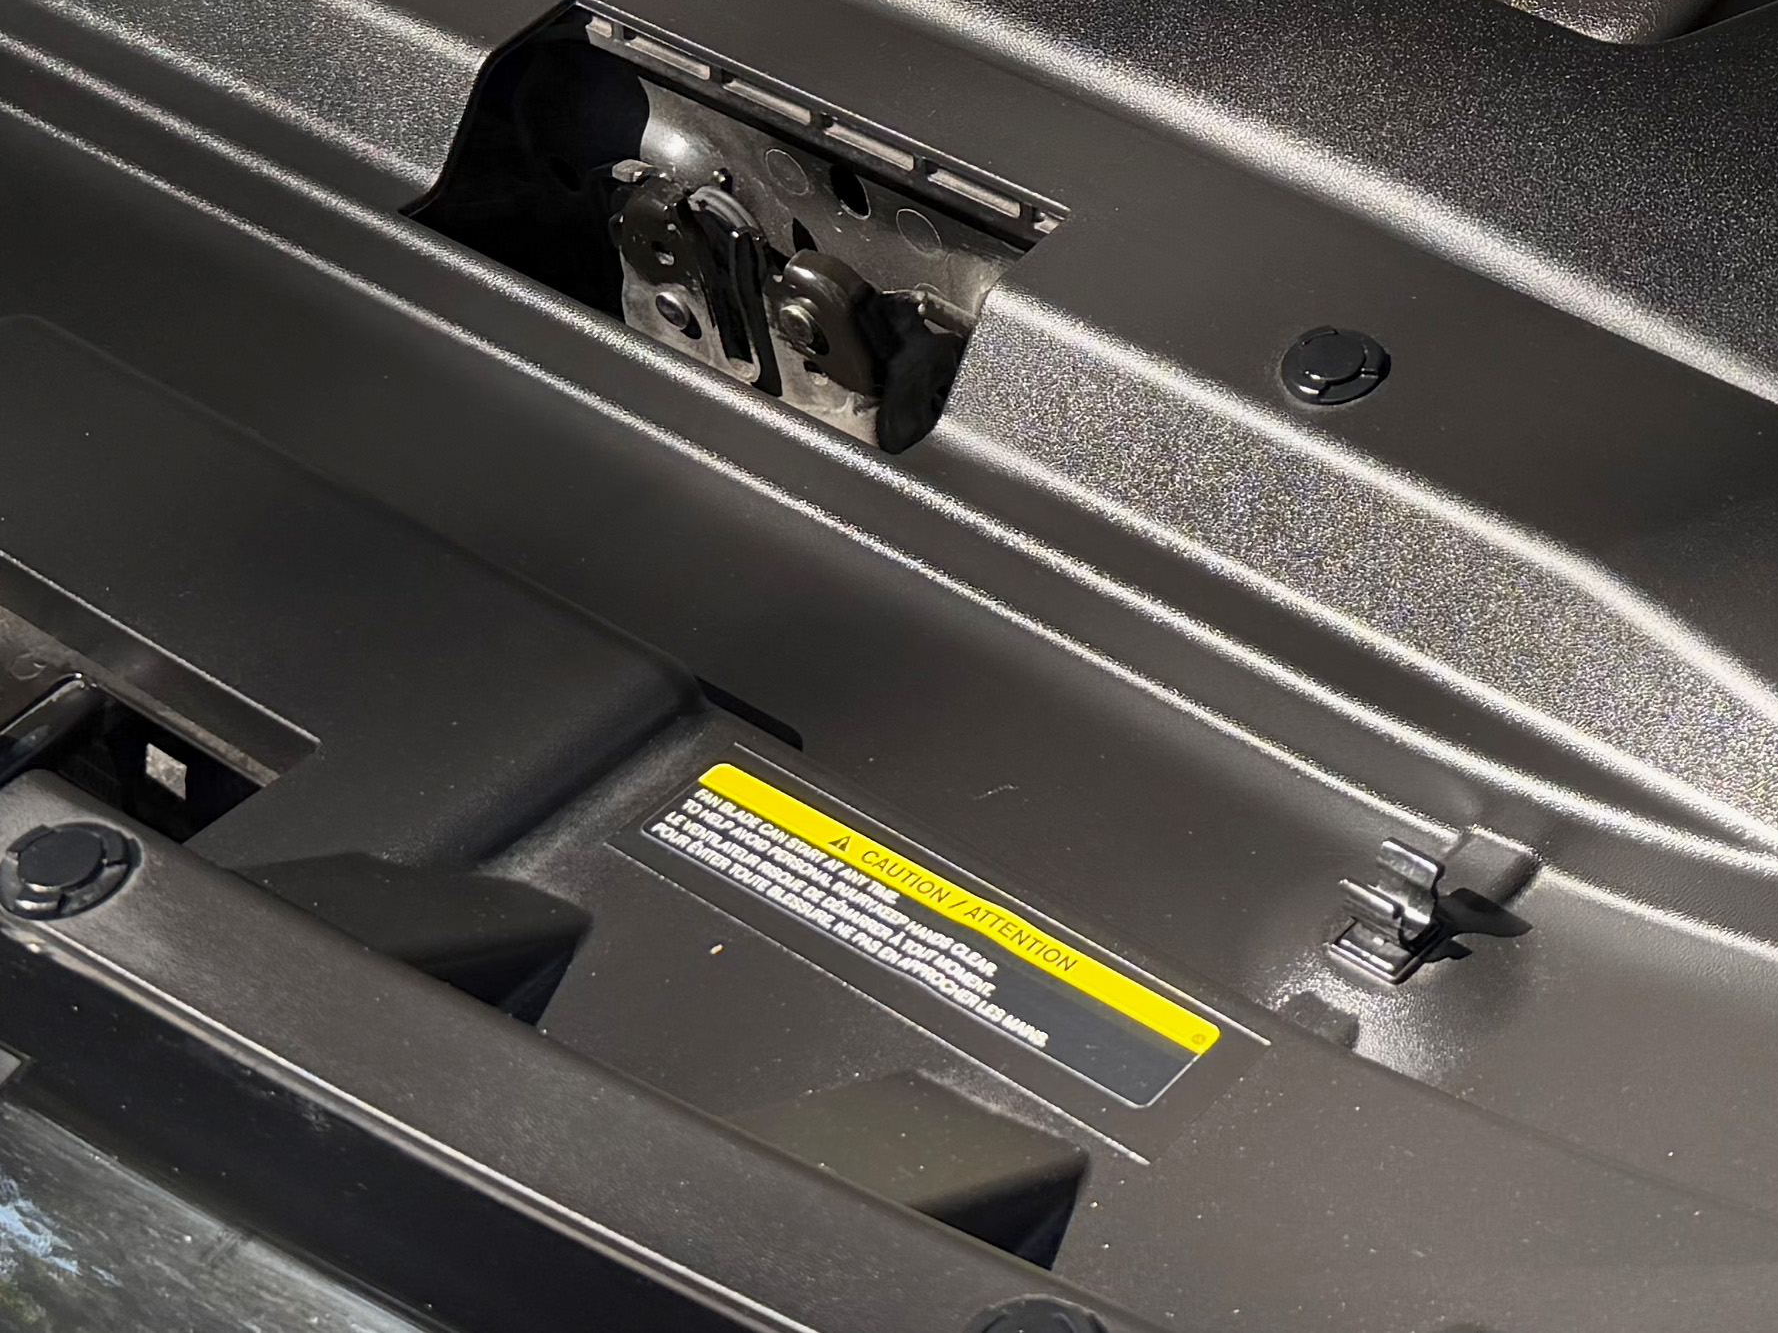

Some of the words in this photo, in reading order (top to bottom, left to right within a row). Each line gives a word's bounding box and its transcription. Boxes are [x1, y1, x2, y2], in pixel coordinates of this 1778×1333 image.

[665, 811, 687, 826] LE
[682, 818, 761, 867] VENTILATEUR
[756, 861, 808, 892] RISQUE
[802, 886, 826, 904] DE
[820, 896, 893, 941] DÉMARRER
[901, 939, 939, 962] TOUT
[682, 799, 702, 814] TO
[699, 809, 735, 833] HELP
[729, 827, 771, 852] AVOID
[767, 846, 833, 888] PERSONAL
[902, 920, 954, 950] HANDS
[694, 789, 723, 808] FAN
[718, 802, 762, 829] BLADE
[758, 824, 789, 844] CAN
[785, 838, 828, 865] START
[822, 859, 844, 873] AT
[838, 868, 870, 886] ANY
[862, 851, 950, 902] CAUTION
[965, 907, 1077, 971] ATTENTION
[651, 822, 692, 850] POUR
[686, 840, 736, 870] ÉVITER
[728, 863, 772, 892] TOUTE
[832, 921, 857, 940] NE
[851, 932, 883, 955] PAS
[877, 946, 902, 964] EN
[896, 953, 984, 1010] APPROCHER
[975, 1000, 1006, 1023] LES
